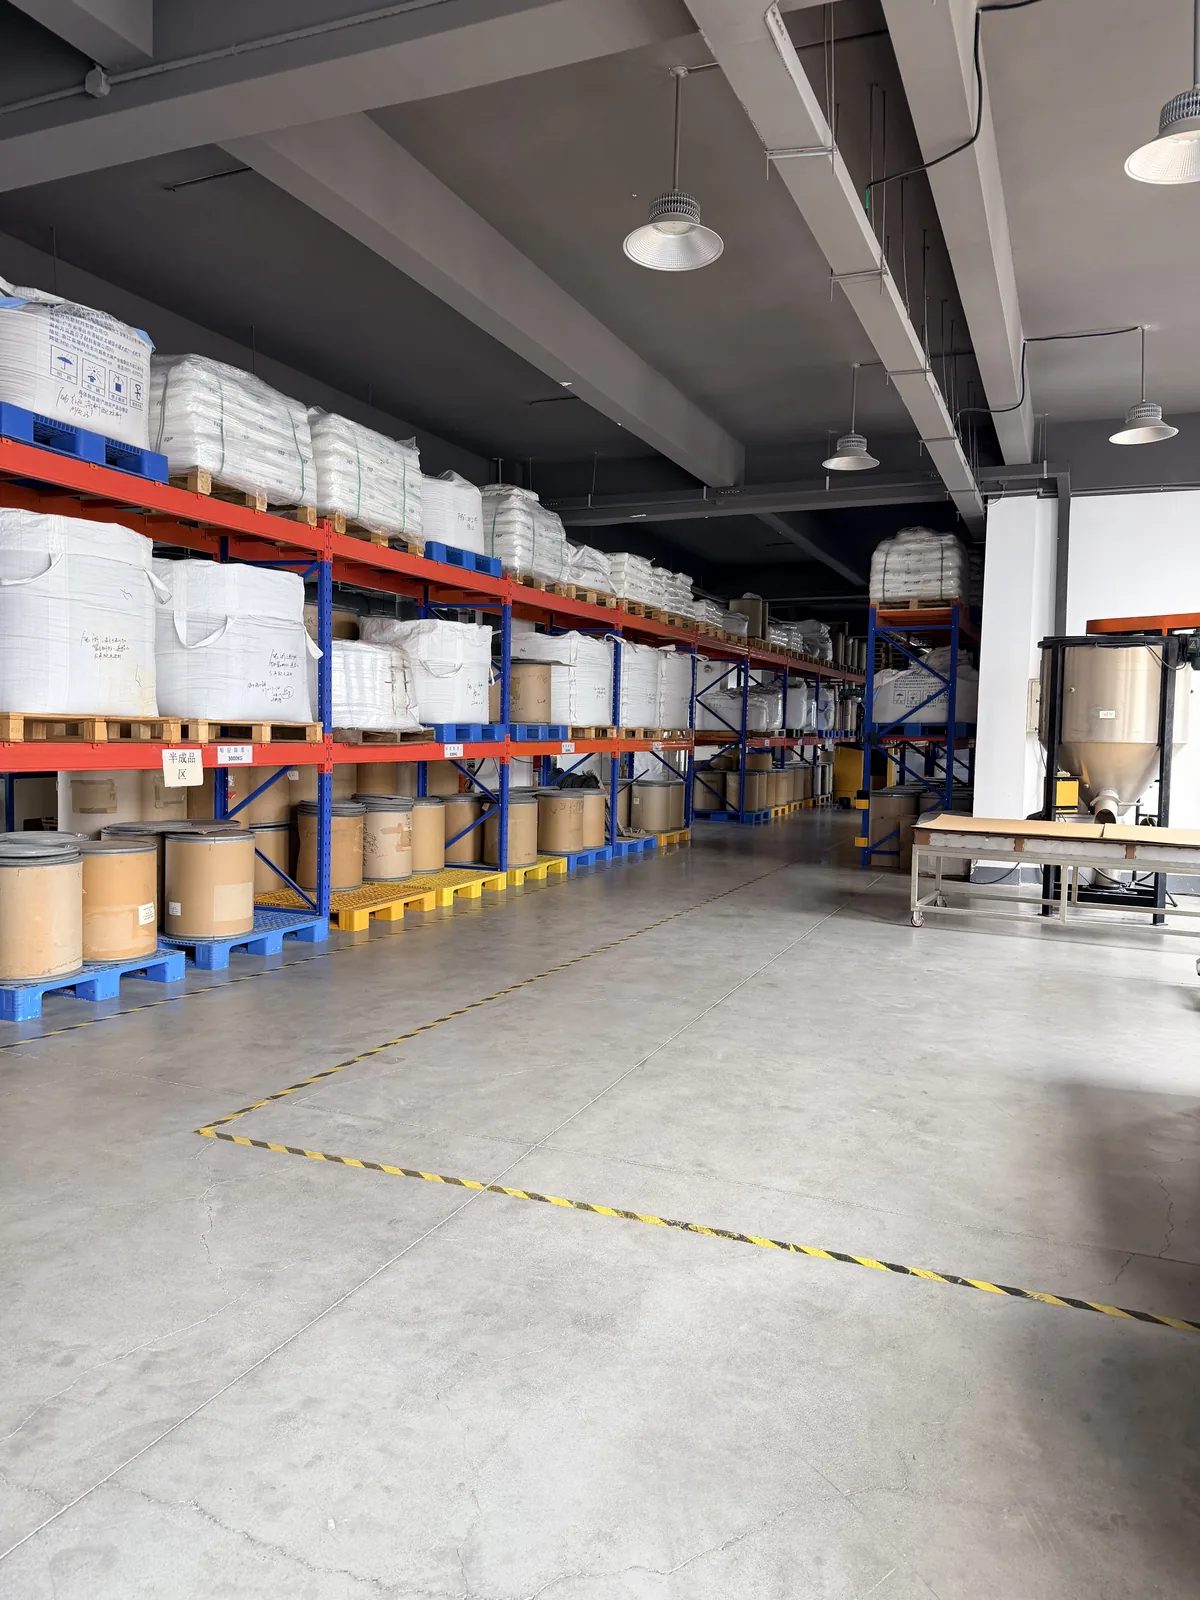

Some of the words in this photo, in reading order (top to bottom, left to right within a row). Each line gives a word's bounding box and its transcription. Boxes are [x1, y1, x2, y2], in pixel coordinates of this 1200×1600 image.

[168, 751, 196, 764] 半成品
[177, 768, 187, 780] 区
